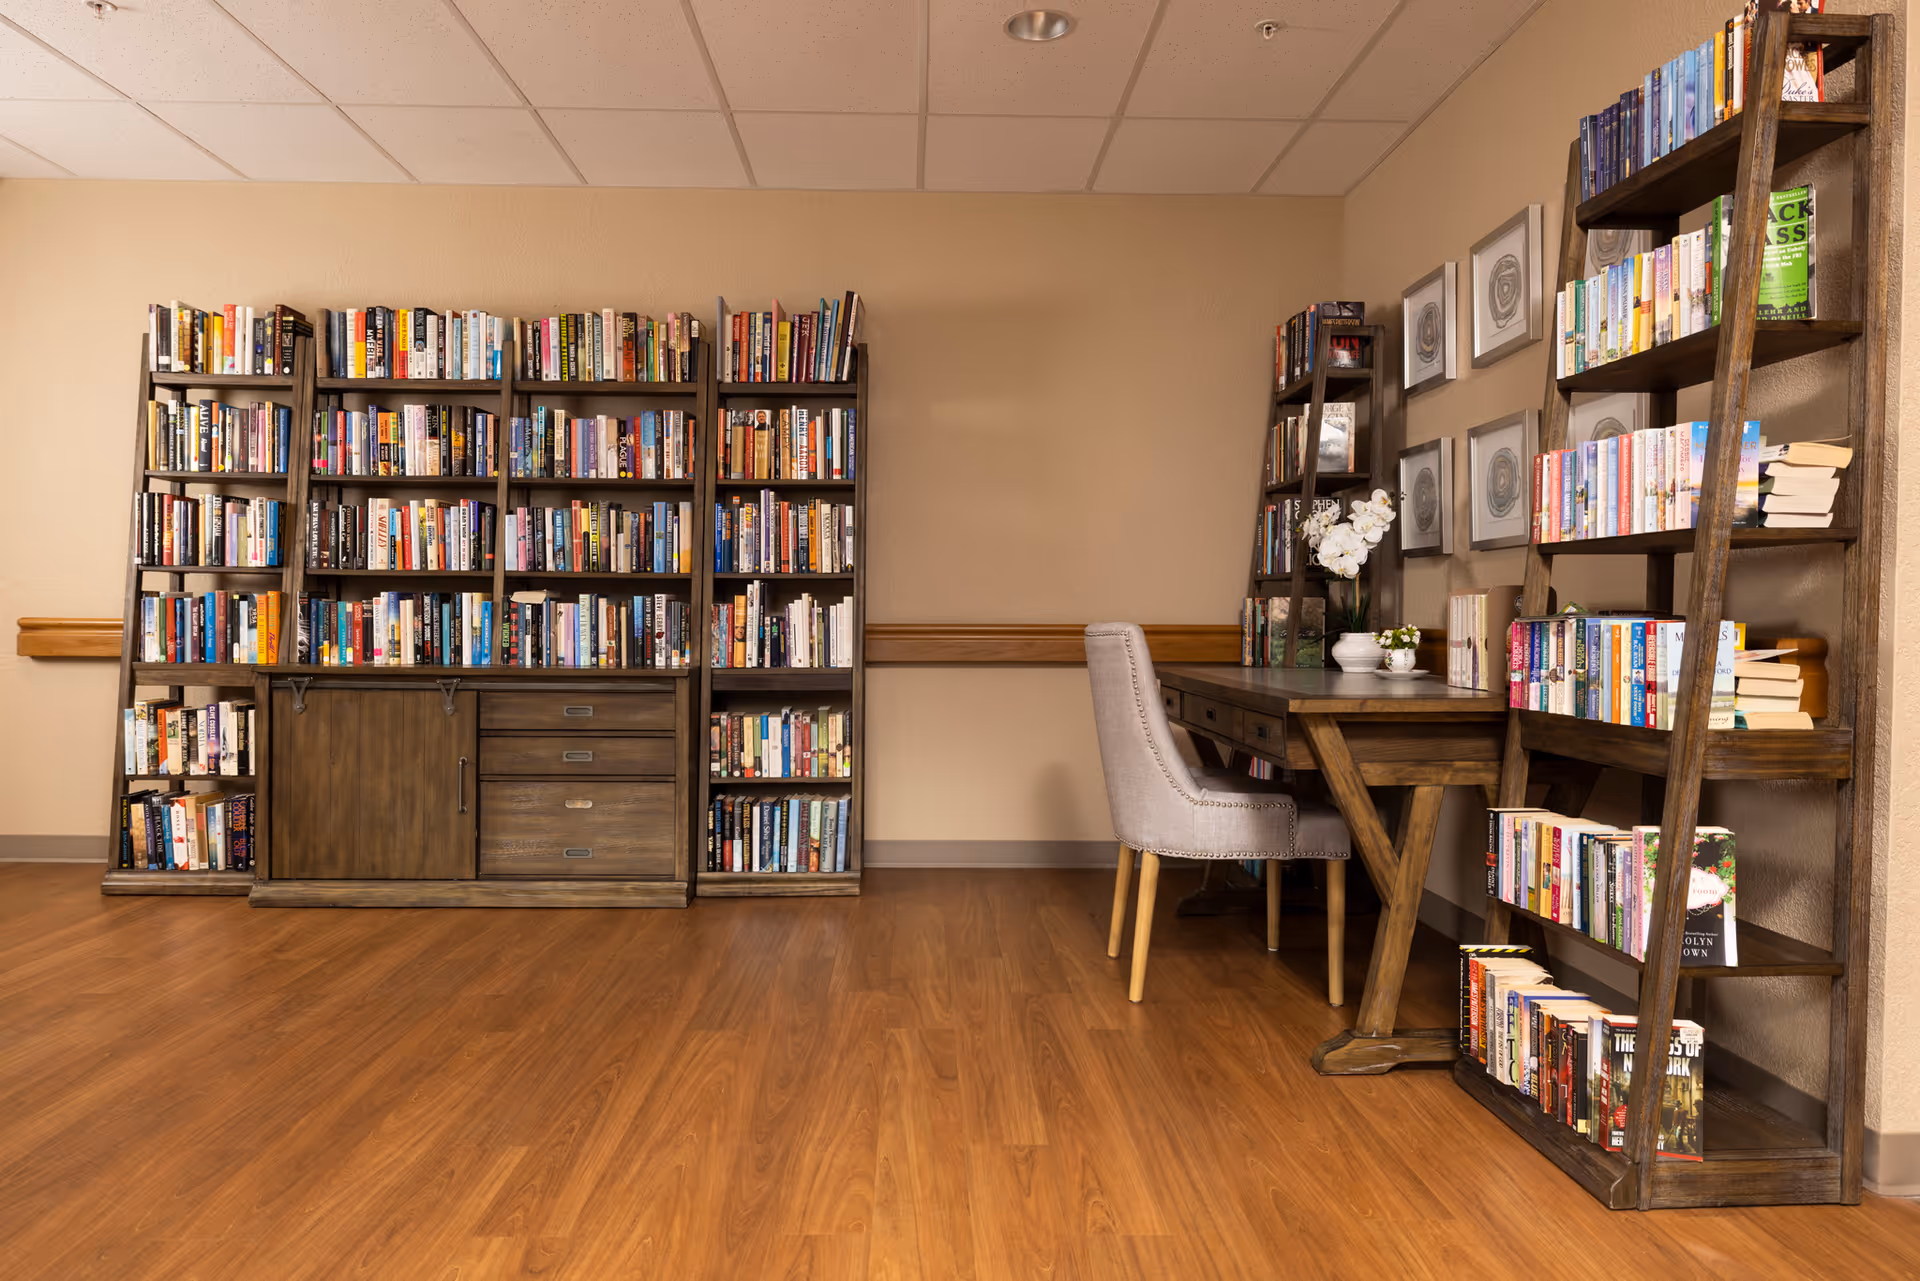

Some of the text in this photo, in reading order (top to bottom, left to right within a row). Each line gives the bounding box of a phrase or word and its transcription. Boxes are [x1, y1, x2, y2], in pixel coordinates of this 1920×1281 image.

[1768, 199, 1814, 223] ACK
[1788, 306, 1806, 314] AND
[802, 316, 810, 337] JFK
[199, 404, 209, 434] ALIVE
[798, 410, 808, 472] HENRY AARON
[1294, 500, 1340, 510] SPHEN
[378, 515, 387, 550] SHELLEY
[502, 622, 510, 648] WICKED
[800, 818, 809, 846] BROWN
[1682, 936, 1713, 946] OLYN
[1683, 949, 1708, 958] OWN
[1470, 979, 1478, 998] JAMES
[1470, 998, 1478, 1026] PATTERSON
[1614, 1033, 1636, 1052] THE
[1686, 1044, 1702, 1058] OF
[1666, 1058, 1690, 1076] ORK
